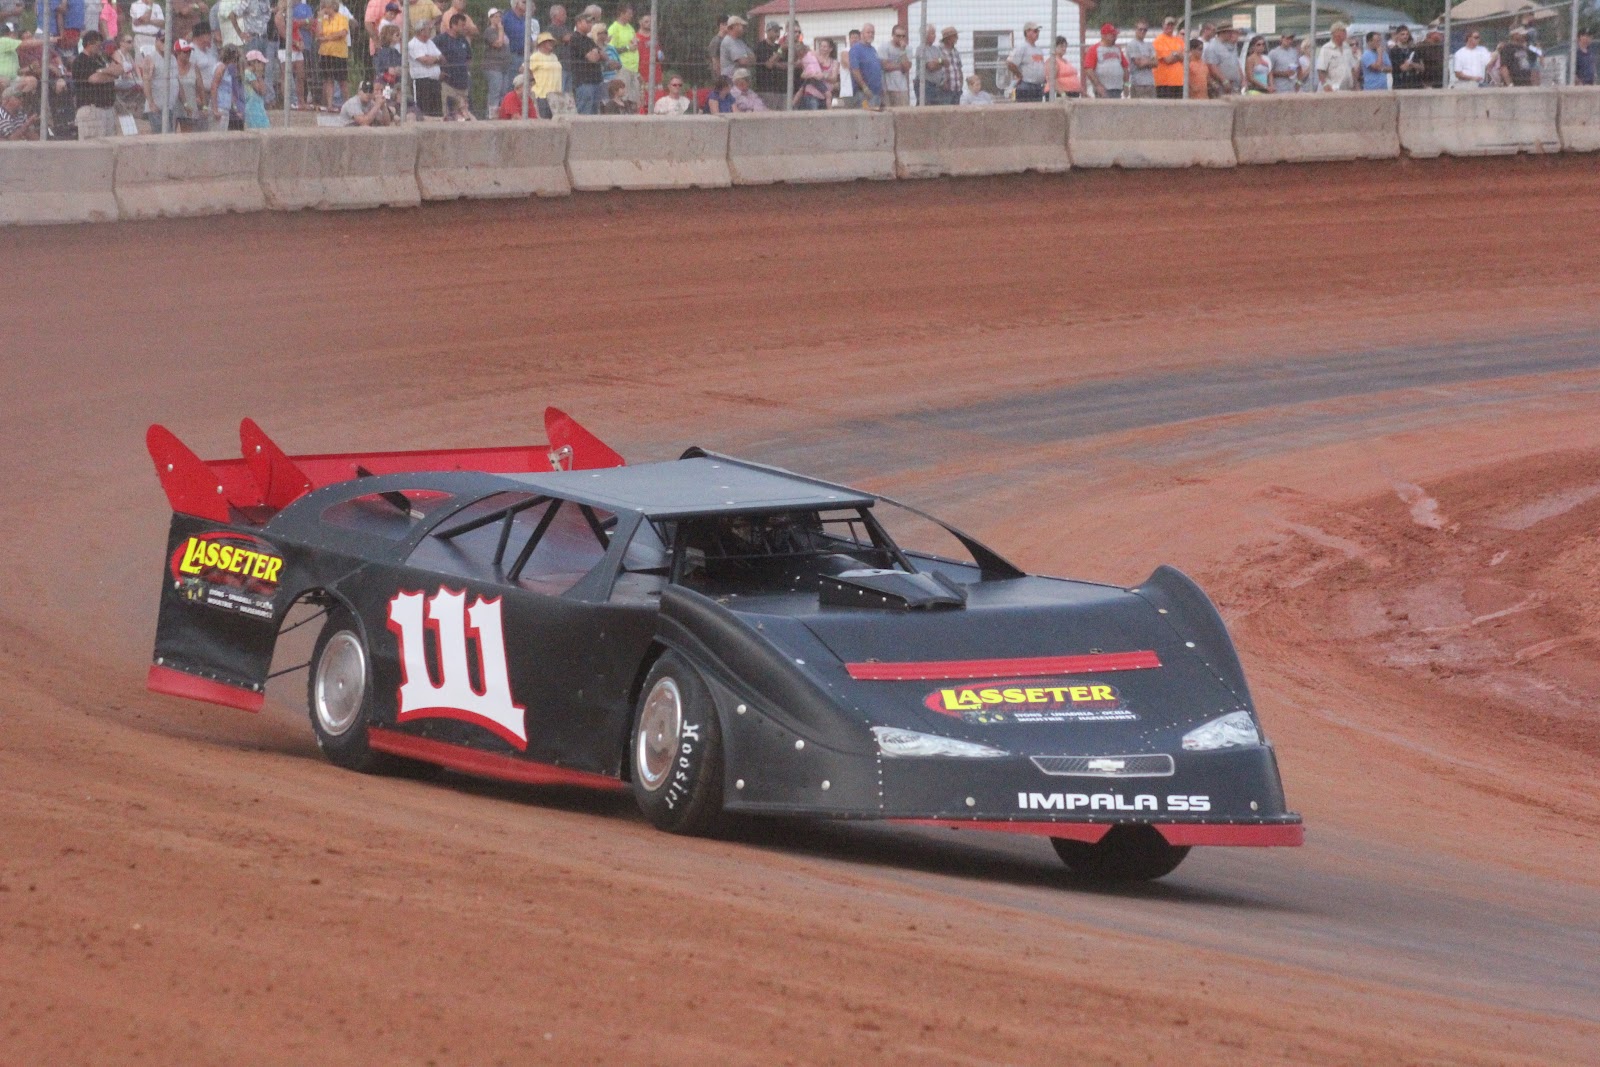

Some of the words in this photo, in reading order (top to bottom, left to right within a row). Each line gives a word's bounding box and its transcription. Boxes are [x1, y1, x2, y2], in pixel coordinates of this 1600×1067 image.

[180, 537, 282, 582] LASSETER
[940, 685, 1116, 710] LASSETER
[1017, 792, 1158, 811] IMPALA
[1166, 795, 1211, 812] SS
